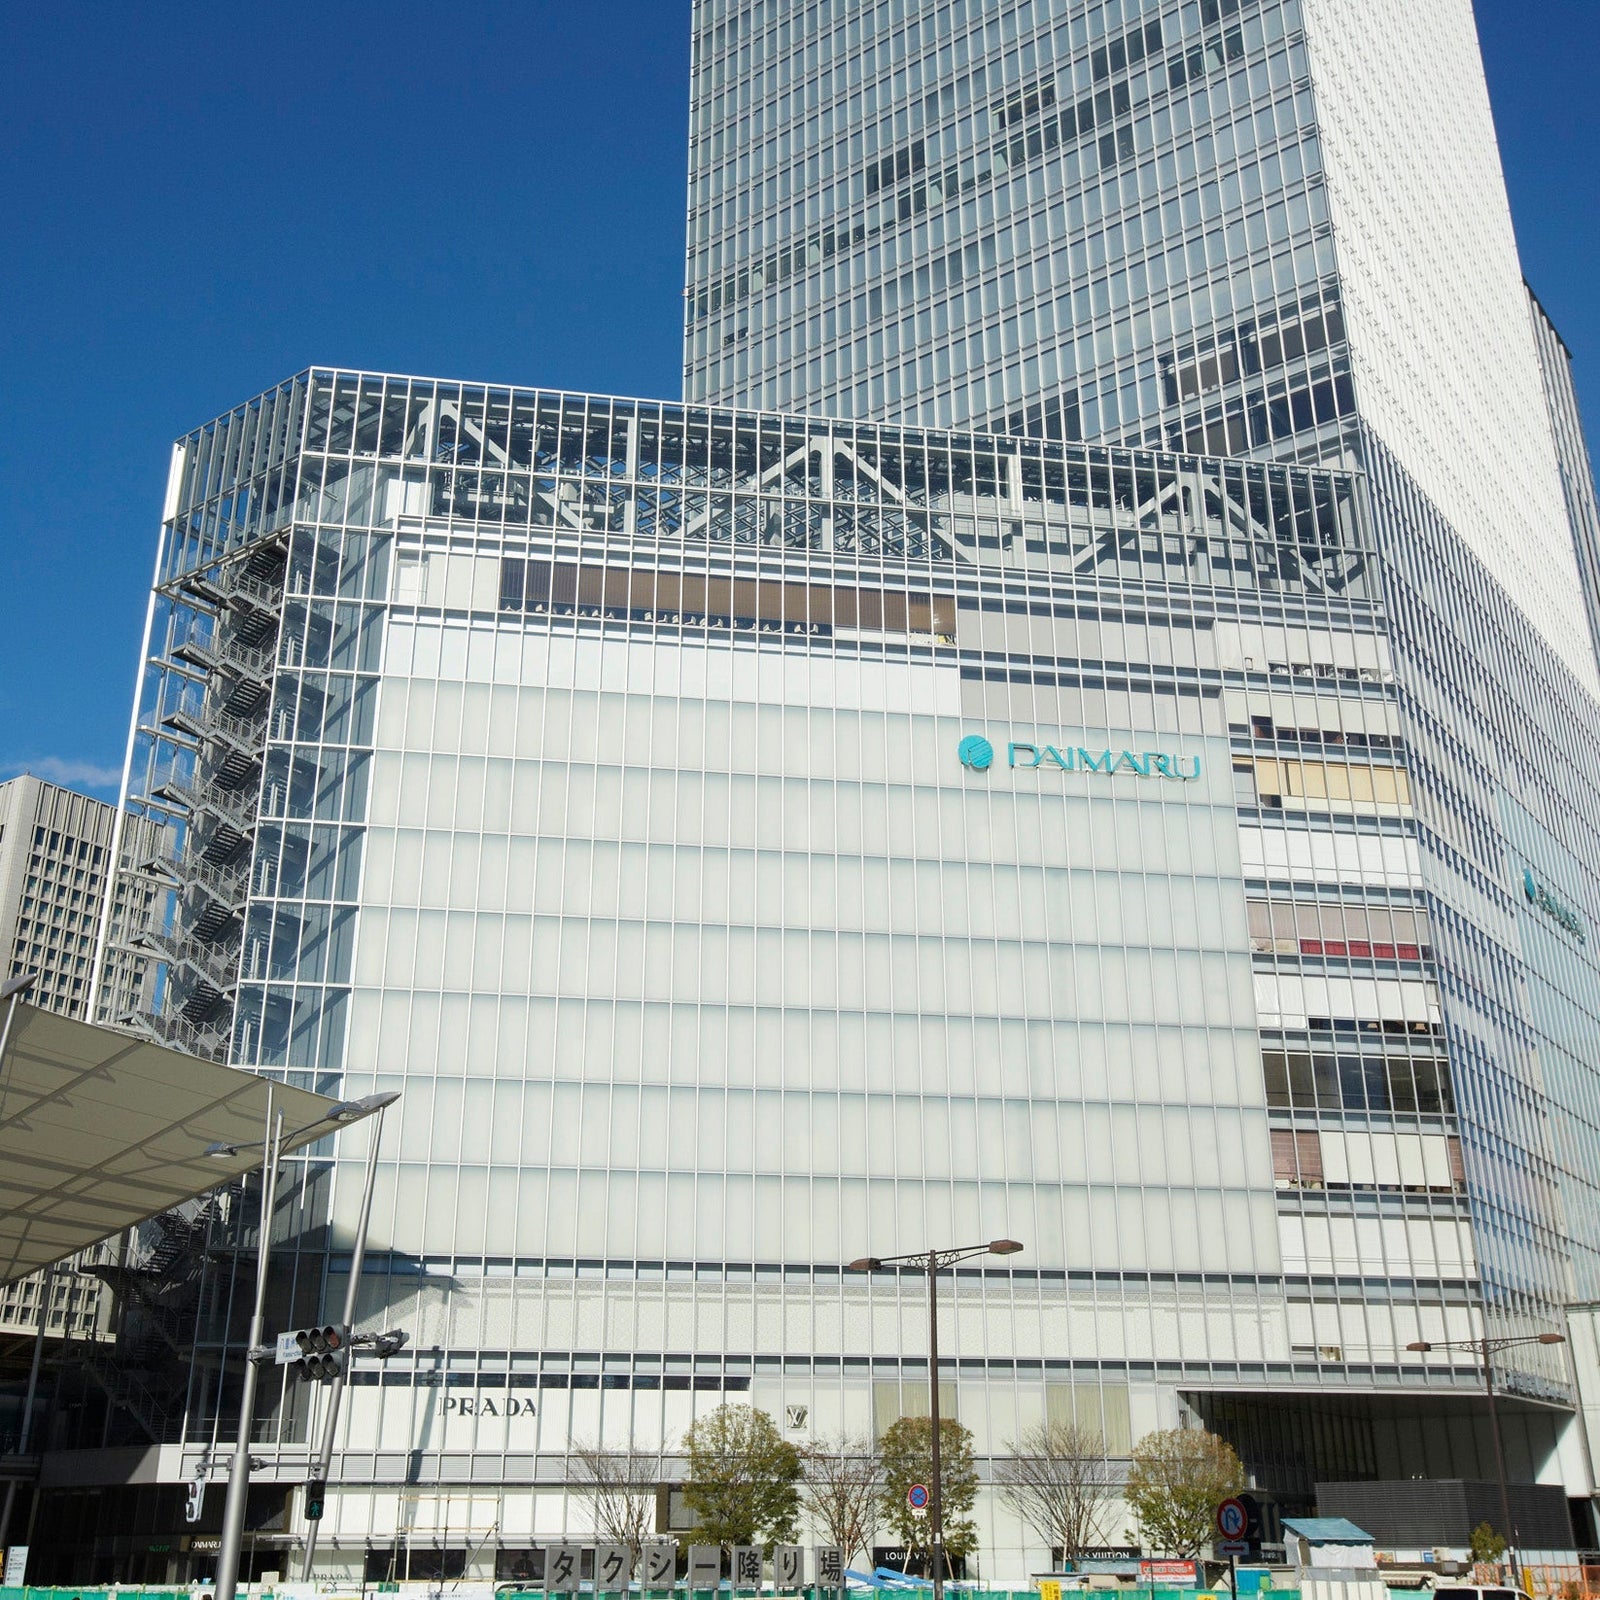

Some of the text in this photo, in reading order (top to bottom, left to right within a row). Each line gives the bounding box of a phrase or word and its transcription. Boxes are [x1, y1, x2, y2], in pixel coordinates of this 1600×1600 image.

[1008, 741, 1200, 779] DAIMARU
[438, 1397, 540, 1417] PRADA
[553, 1550, 841, 1585] タクシー降り場
